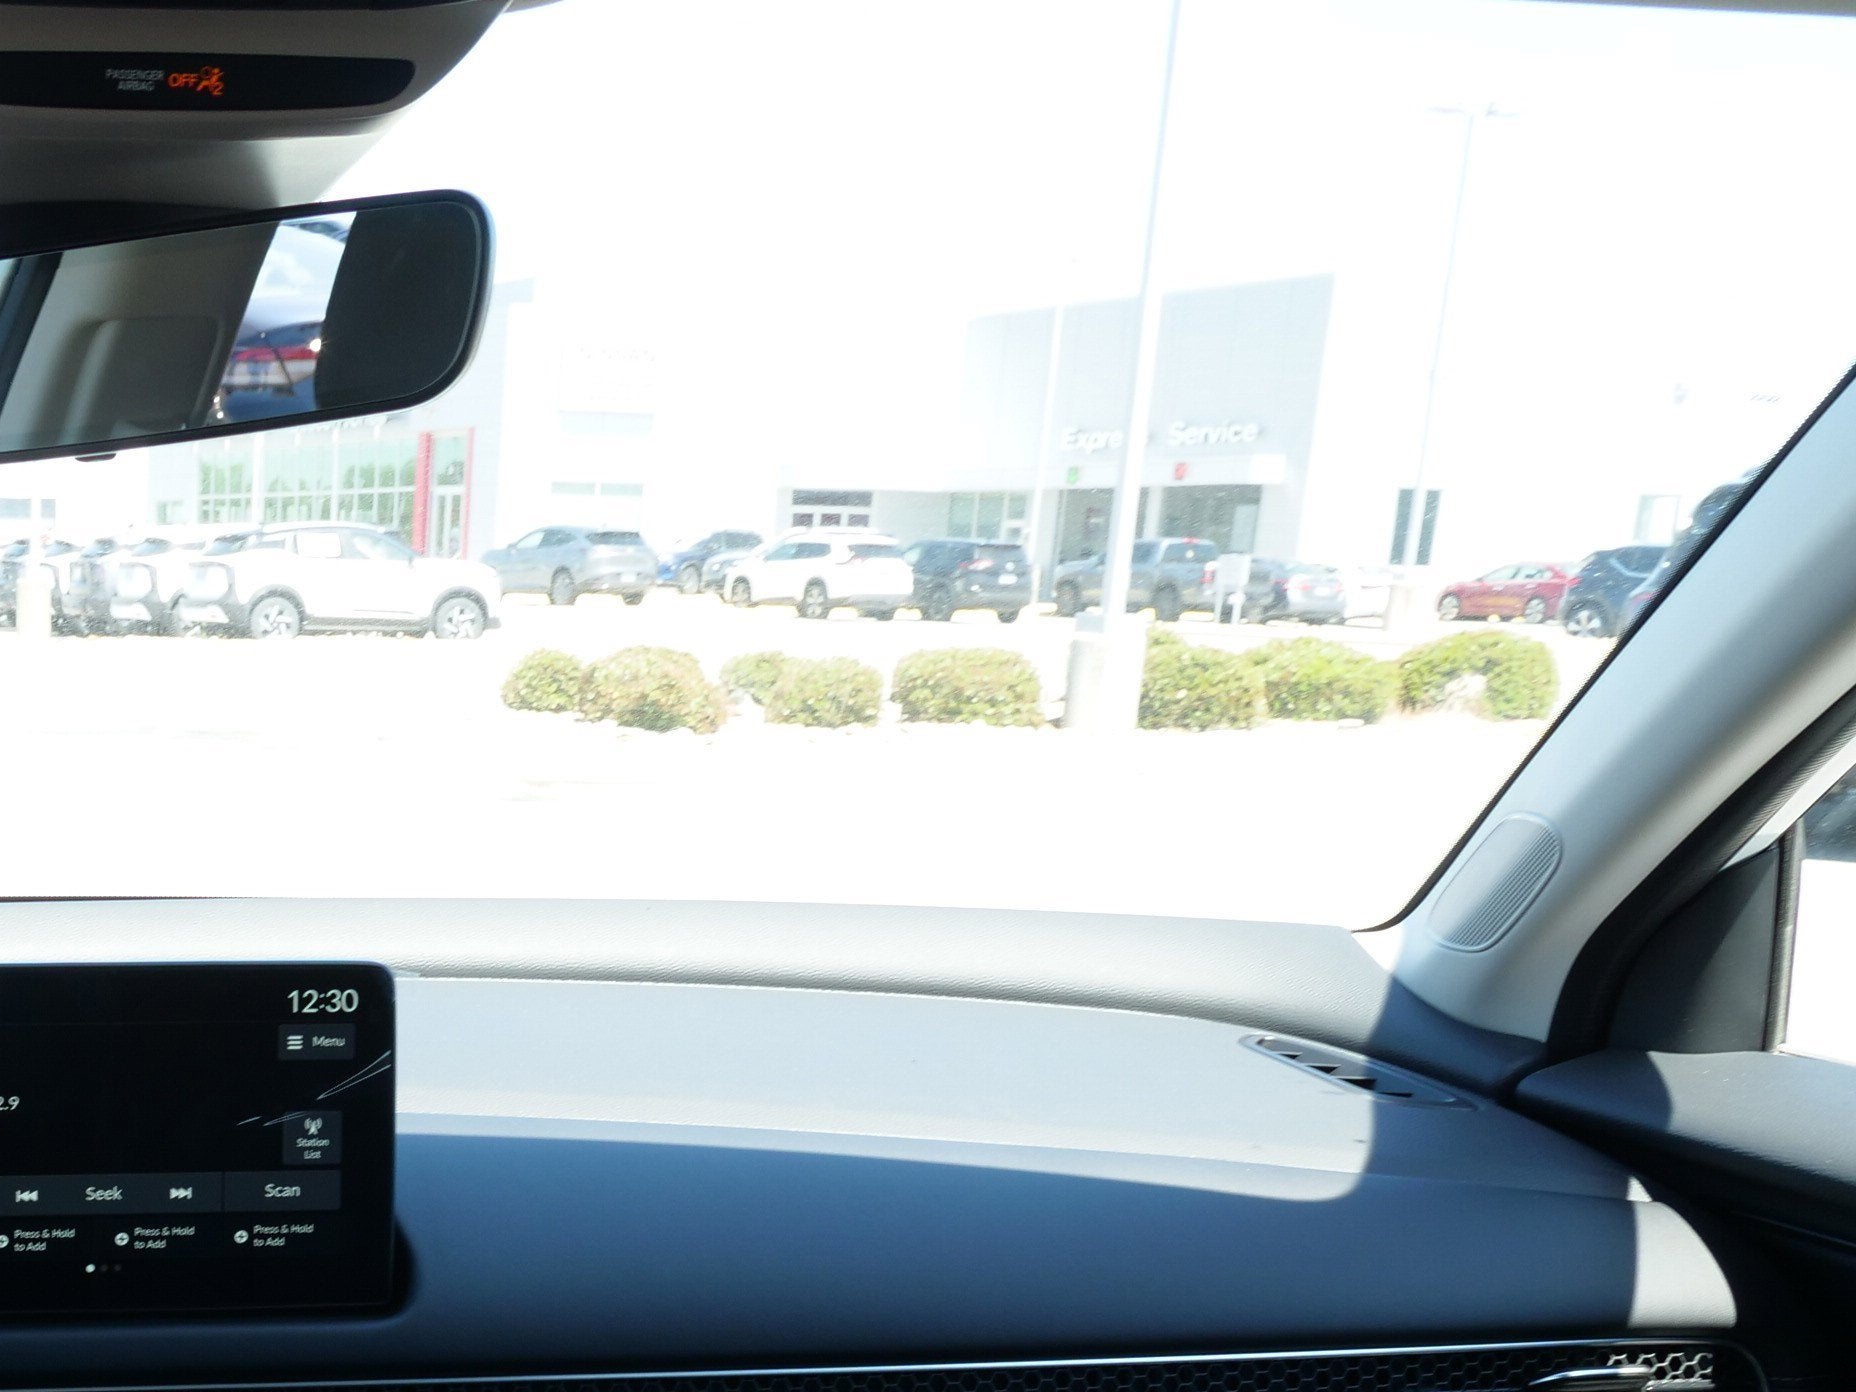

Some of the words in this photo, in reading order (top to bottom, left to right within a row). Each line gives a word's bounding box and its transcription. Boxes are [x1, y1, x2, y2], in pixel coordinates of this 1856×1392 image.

[105, 69, 164, 80] PASSENGER
[167, 72, 199, 88] OFF
[117, 81, 155, 91] AIRBAG
[1060, 427, 1150, 454] Expre
[1169, 420, 1260, 447] Service
[287, 989, 360, 1013] 12:30
[311, 1035, 346, 1048] Menu
[296, 1138, 330, 1148] Station
[303, 1150, 322, 1160] List
[84, 1186, 123, 1202] Seek
[264, 1183, 302, 1198] Scan
[13, 1229, 40, 1239] Press
[41, 1229, 50, 1239] &
[51, 1228, 76, 1238] Hold
[134, 1227, 160, 1237] Press
[161, 1227, 169, 1236] &
[171, 1226, 195, 1236] Hold
[253, 1225, 279, 1234] Press
[280, 1225, 289, 1234] &
[290, 1224, 314, 1233] Hold
[13, 1243, 25, 1252] to
[26, 1241, 47, 1251] Add
[134, 1241, 145, 1249] to
[146, 1240, 167, 1249] Add
[253, 1238, 264, 1247] to
[265, 1237, 285, 1247] Add
